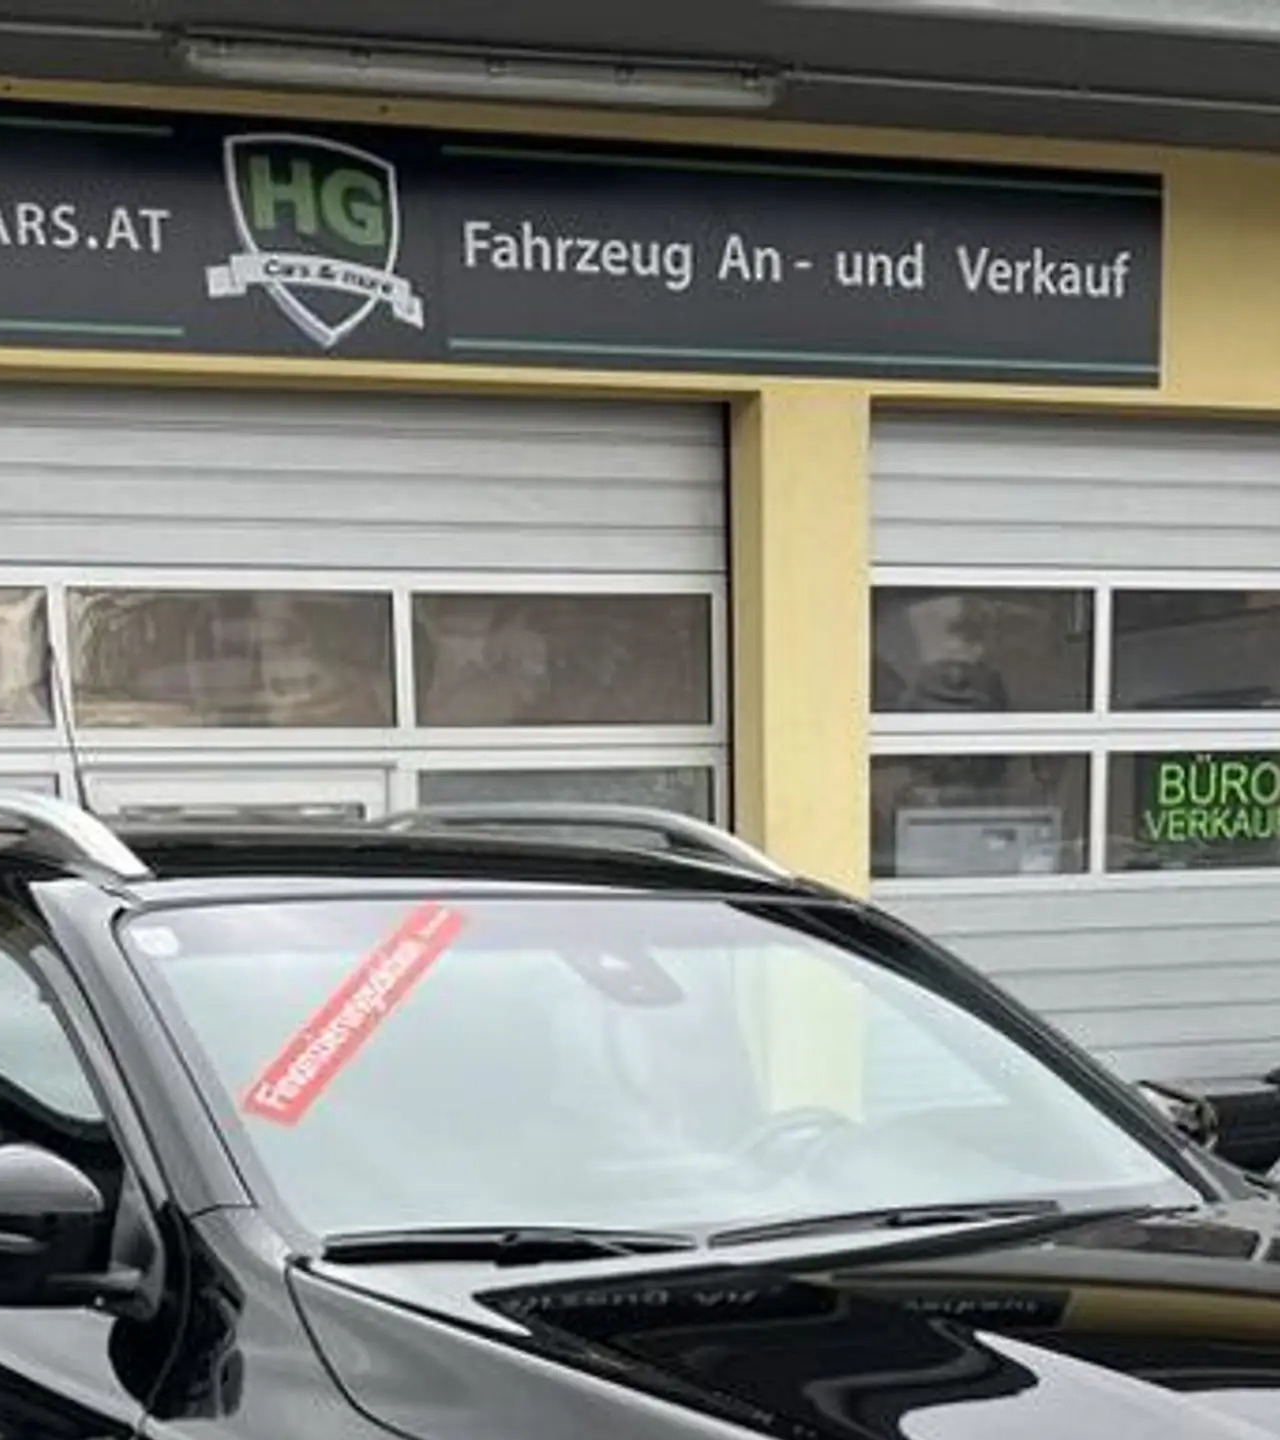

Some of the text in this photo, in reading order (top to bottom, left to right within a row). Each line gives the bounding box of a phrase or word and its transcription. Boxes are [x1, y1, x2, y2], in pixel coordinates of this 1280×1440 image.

[249, 155, 386, 246] HG
[463, 221, 694, 291] Fahrzeug
[837, 243, 924, 289] und
[958, 247, 1130, 299] Verkauf
